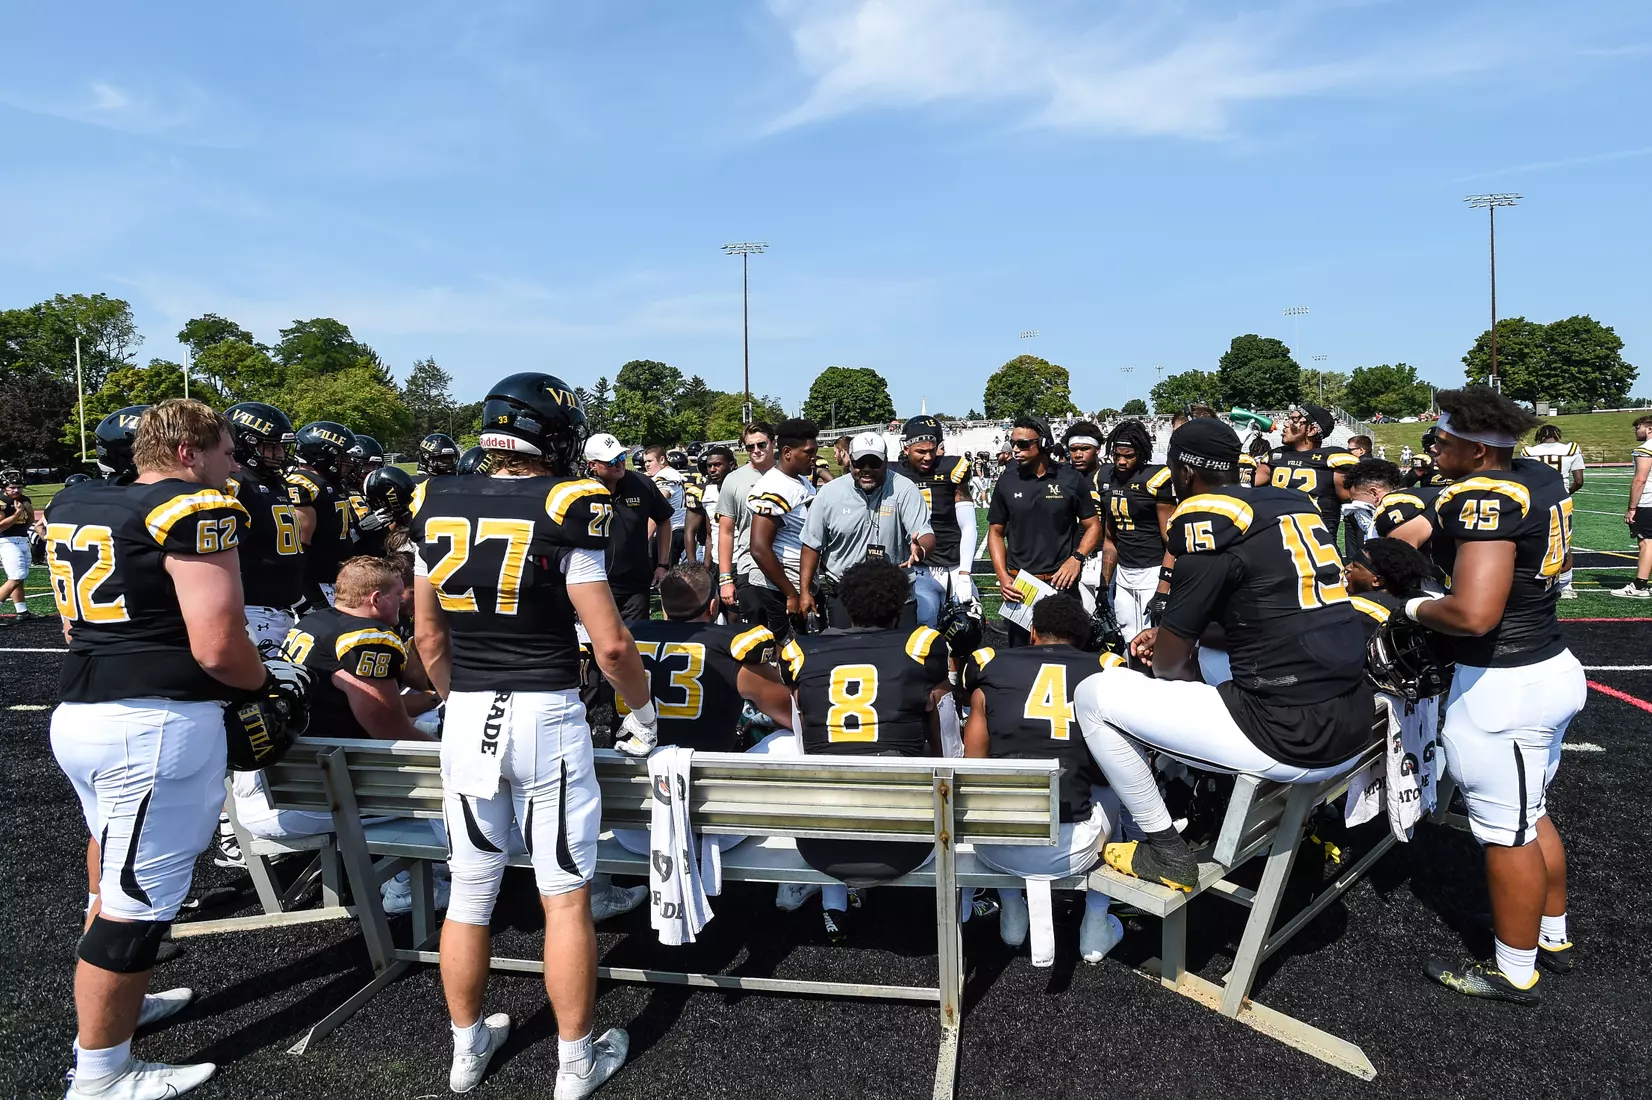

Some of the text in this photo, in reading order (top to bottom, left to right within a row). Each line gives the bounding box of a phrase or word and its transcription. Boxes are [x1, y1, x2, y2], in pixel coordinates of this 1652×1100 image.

[232, 408, 274, 435] VILLE
[498, 415, 508, 424] 33
[312, 427, 347, 447] VILLE
[480, 437, 516, 449] Riddell
[1179, 452, 1205, 467] NIKE
[588, 502, 614, 538] 27
[1110, 496, 1135, 531] 11
[1458, 499, 1500, 531] 45
[196, 515, 238, 554] 62
[1184, 520, 1216, 553] 15
[424, 516, 535, 616] 27
[868, 548, 884, 557] VILLE
[1276, 513, 1351, 610] 15
[46, 522, 131, 624] 62
[355, 650, 391, 678] 68
[827, 663, 879, 743] 8
[1023, 663, 1075, 740] 4
[237, 703, 275, 762] VILLE
